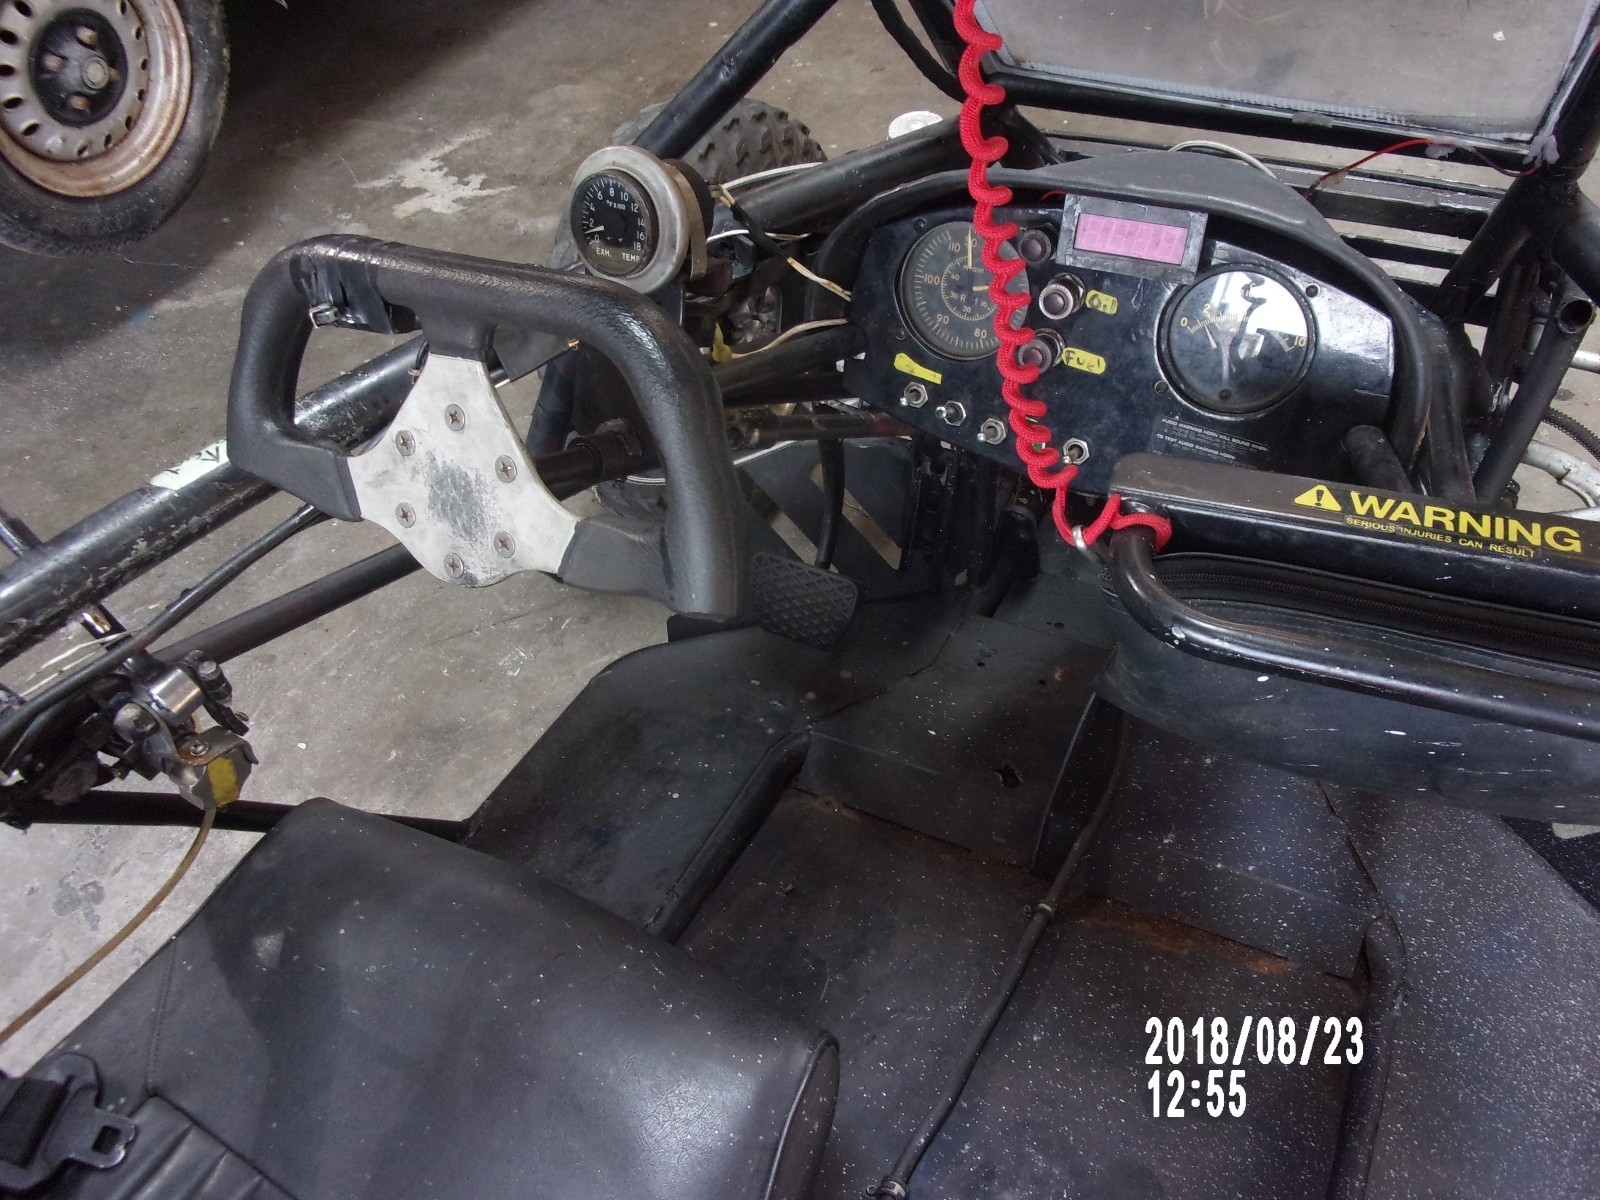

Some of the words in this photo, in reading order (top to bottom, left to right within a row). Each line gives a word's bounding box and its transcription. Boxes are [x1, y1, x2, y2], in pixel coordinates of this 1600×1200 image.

[598, 192, 603, 201] 6
[609, 188, 615, 197] 8
[620, 192, 629, 202] 10
[589, 204, 595, 212] 4
[631, 203, 639, 212] 12
[589, 219, 595, 227] 2
[637, 218, 645, 227] 14
[594, 235, 600, 243] 0
[637, 232, 645, 240] 16
[948, 241, 961, 252] 110
[924, 274, 941, 285] 100
[962, 305, 972, 314] 20
[1203, 304, 1211, 313] 2
[936, 314, 949, 325] 90
[1180, 316, 1188, 327] 0
[974, 328, 988, 339] 80
[1294, 335, 1306, 347] 10
[1065, 350, 1100, 371] Fuel
[1179, 422, 1202, 433] WARNING
[1195, 444, 1219, 455] WARNING
[1350, 491, 1582, 552] WARNING
[1346, 517, 1396, 533] SERIOUS
[1400, 527, 1452, 543] INJURIES
[1458, 538, 1483, 549] CAN
[1489, 543, 1536, 558] RESULT
